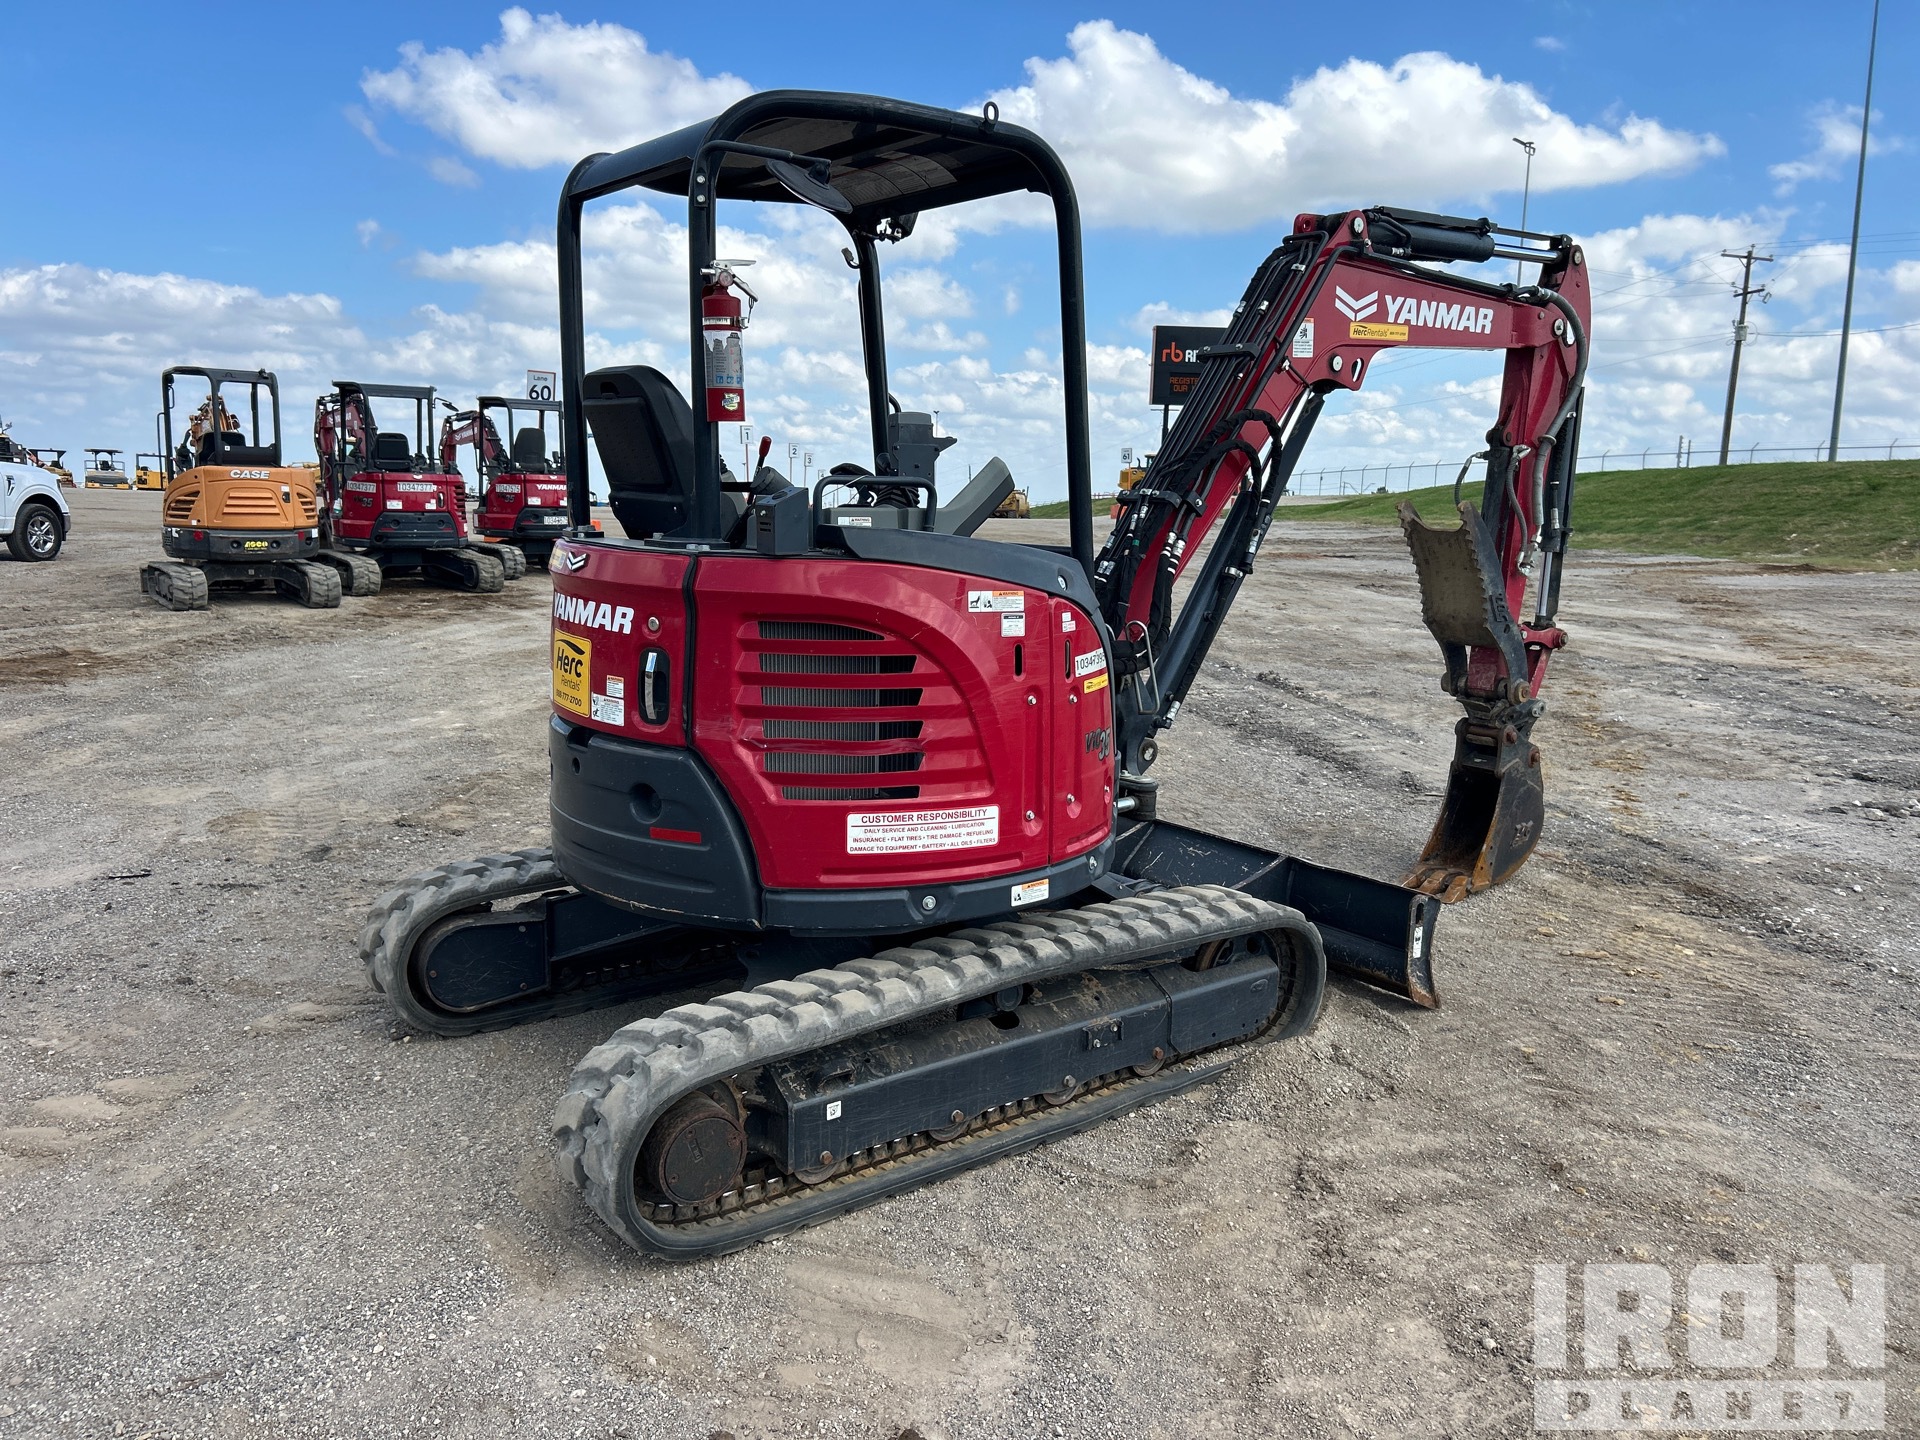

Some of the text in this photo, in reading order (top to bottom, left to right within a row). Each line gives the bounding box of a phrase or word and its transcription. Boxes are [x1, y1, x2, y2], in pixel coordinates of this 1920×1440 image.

[1385, 295, 1494, 334] YANMAR
[1162, 341, 1183, 362] rb
[529, 385, 551, 400] 60
[229, 469, 271, 479] CASE
[398, 482, 432, 491] 10347377
[554, 592, 634, 635] YANMAR
[556, 647, 584, 678] Herc
[561, 676, 581, 692] Rentals
[861, 808, 988, 824] CUSTOMER RESPONSIBILITY
